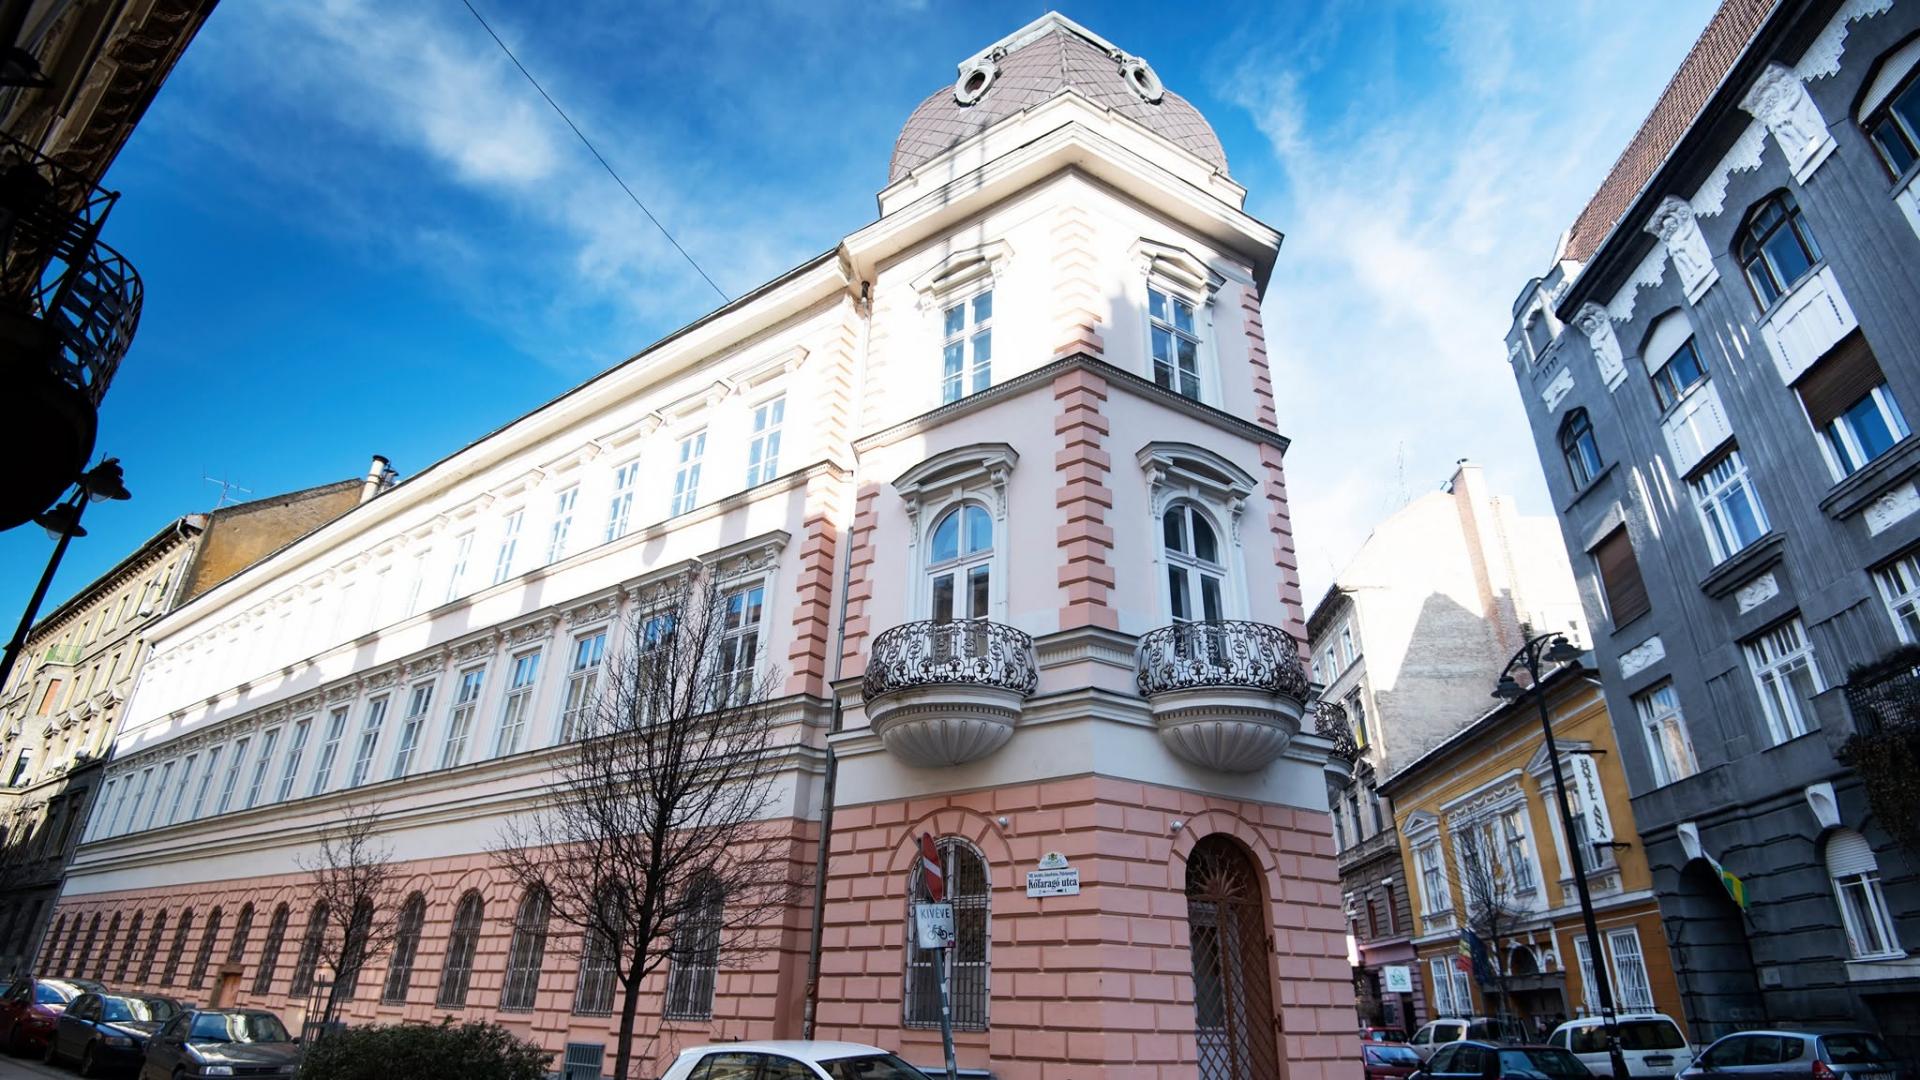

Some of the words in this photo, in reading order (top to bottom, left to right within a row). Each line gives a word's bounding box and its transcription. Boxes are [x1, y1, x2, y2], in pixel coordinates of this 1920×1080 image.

[1579, 758, 1597, 801] HOTEL
[1593, 803, 1607, 839] ANNA
[1028, 878, 1060, 889] Kőfaragó
[1062, 878, 1078, 887] utca
[920, 906, 950, 919] KIVÉVE
